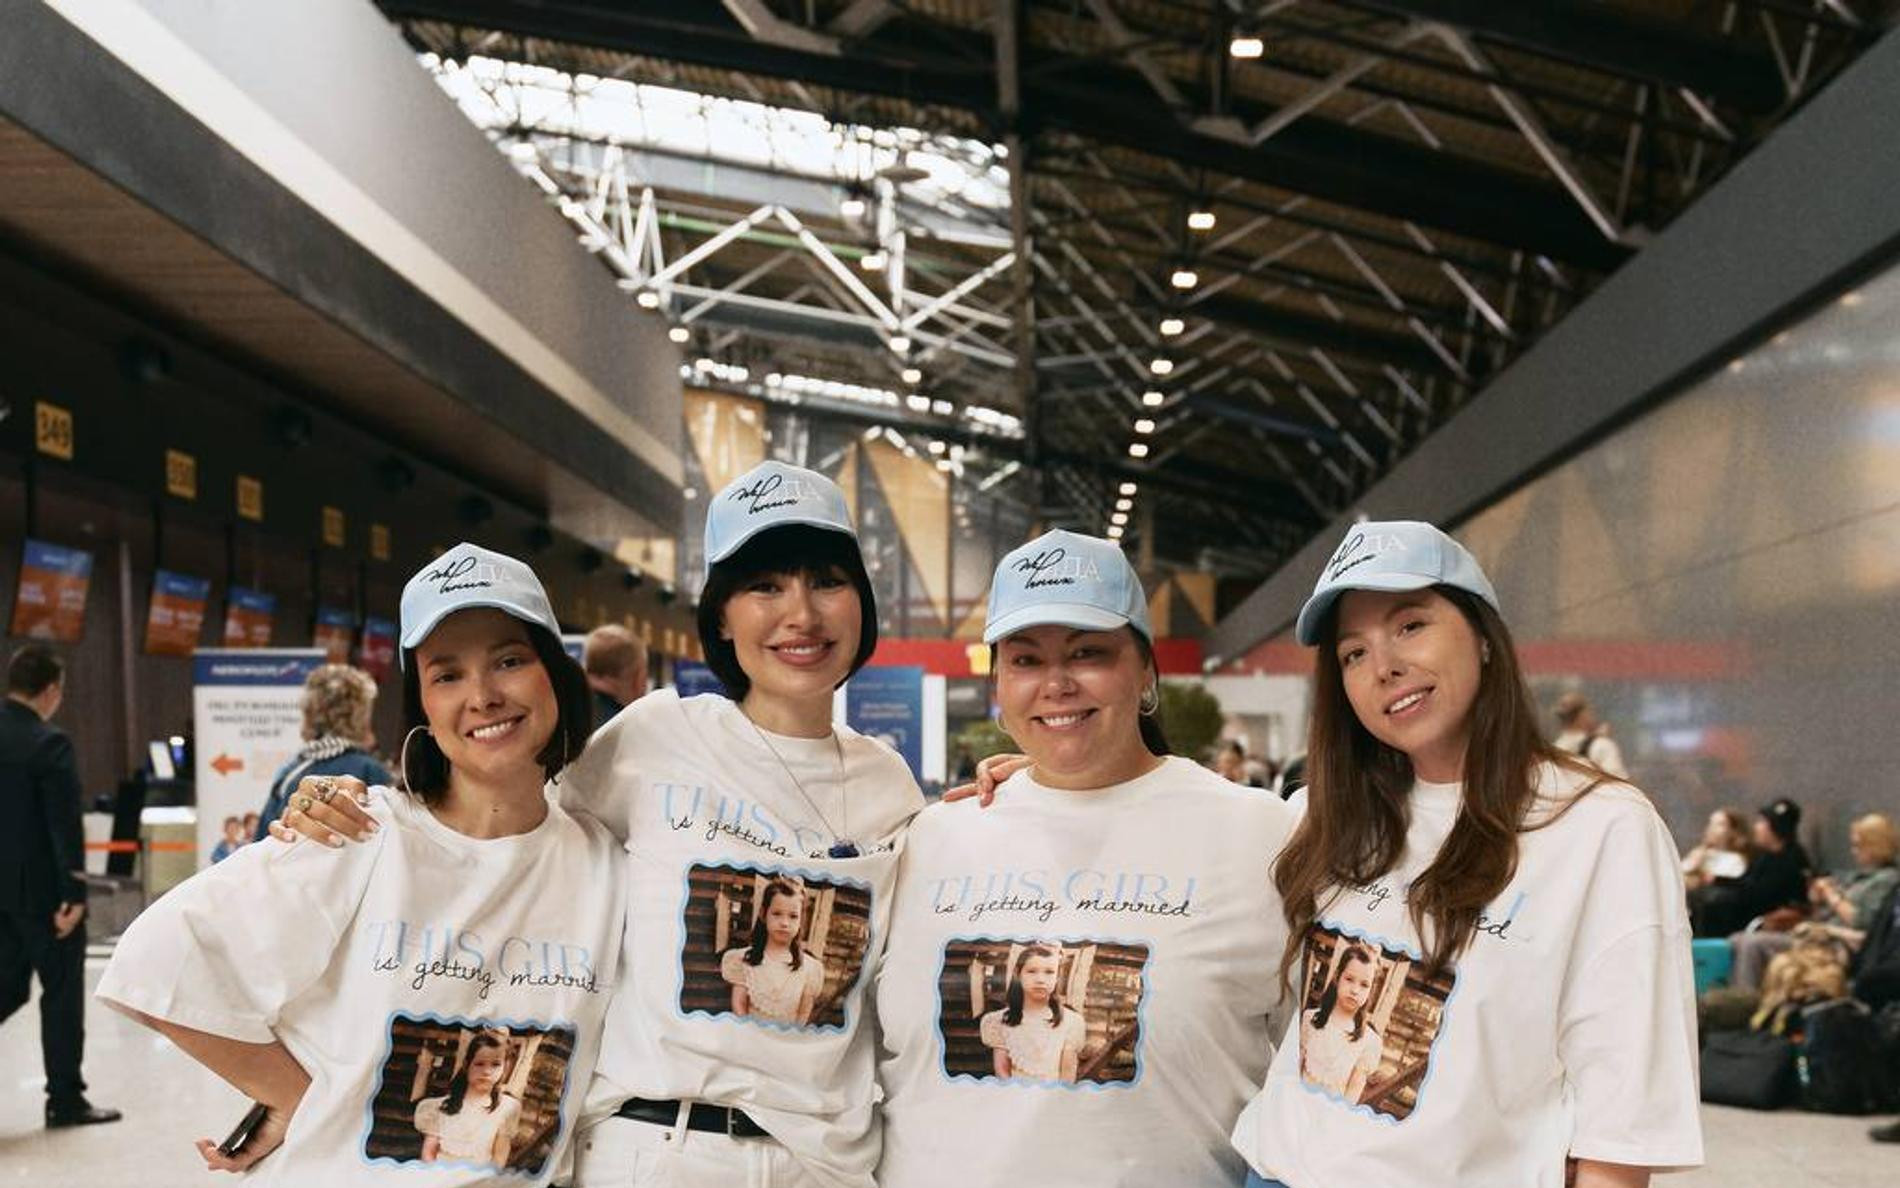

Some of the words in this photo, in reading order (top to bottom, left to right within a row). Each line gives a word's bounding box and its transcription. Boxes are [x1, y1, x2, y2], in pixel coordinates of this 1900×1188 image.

[652, 783, 779, 842] THIS
[671, 815, 693, 830] is
[927, 869, 1048, 909] THIS
[935, 902, 959, 914] is
[968, 895, 1061, 922] getting
[1074, 897, 1191, 918] married
[367, 920, 485, 972] THIS
[374, 954, 400, 972] is
[411, 959, 497, 999] getting
